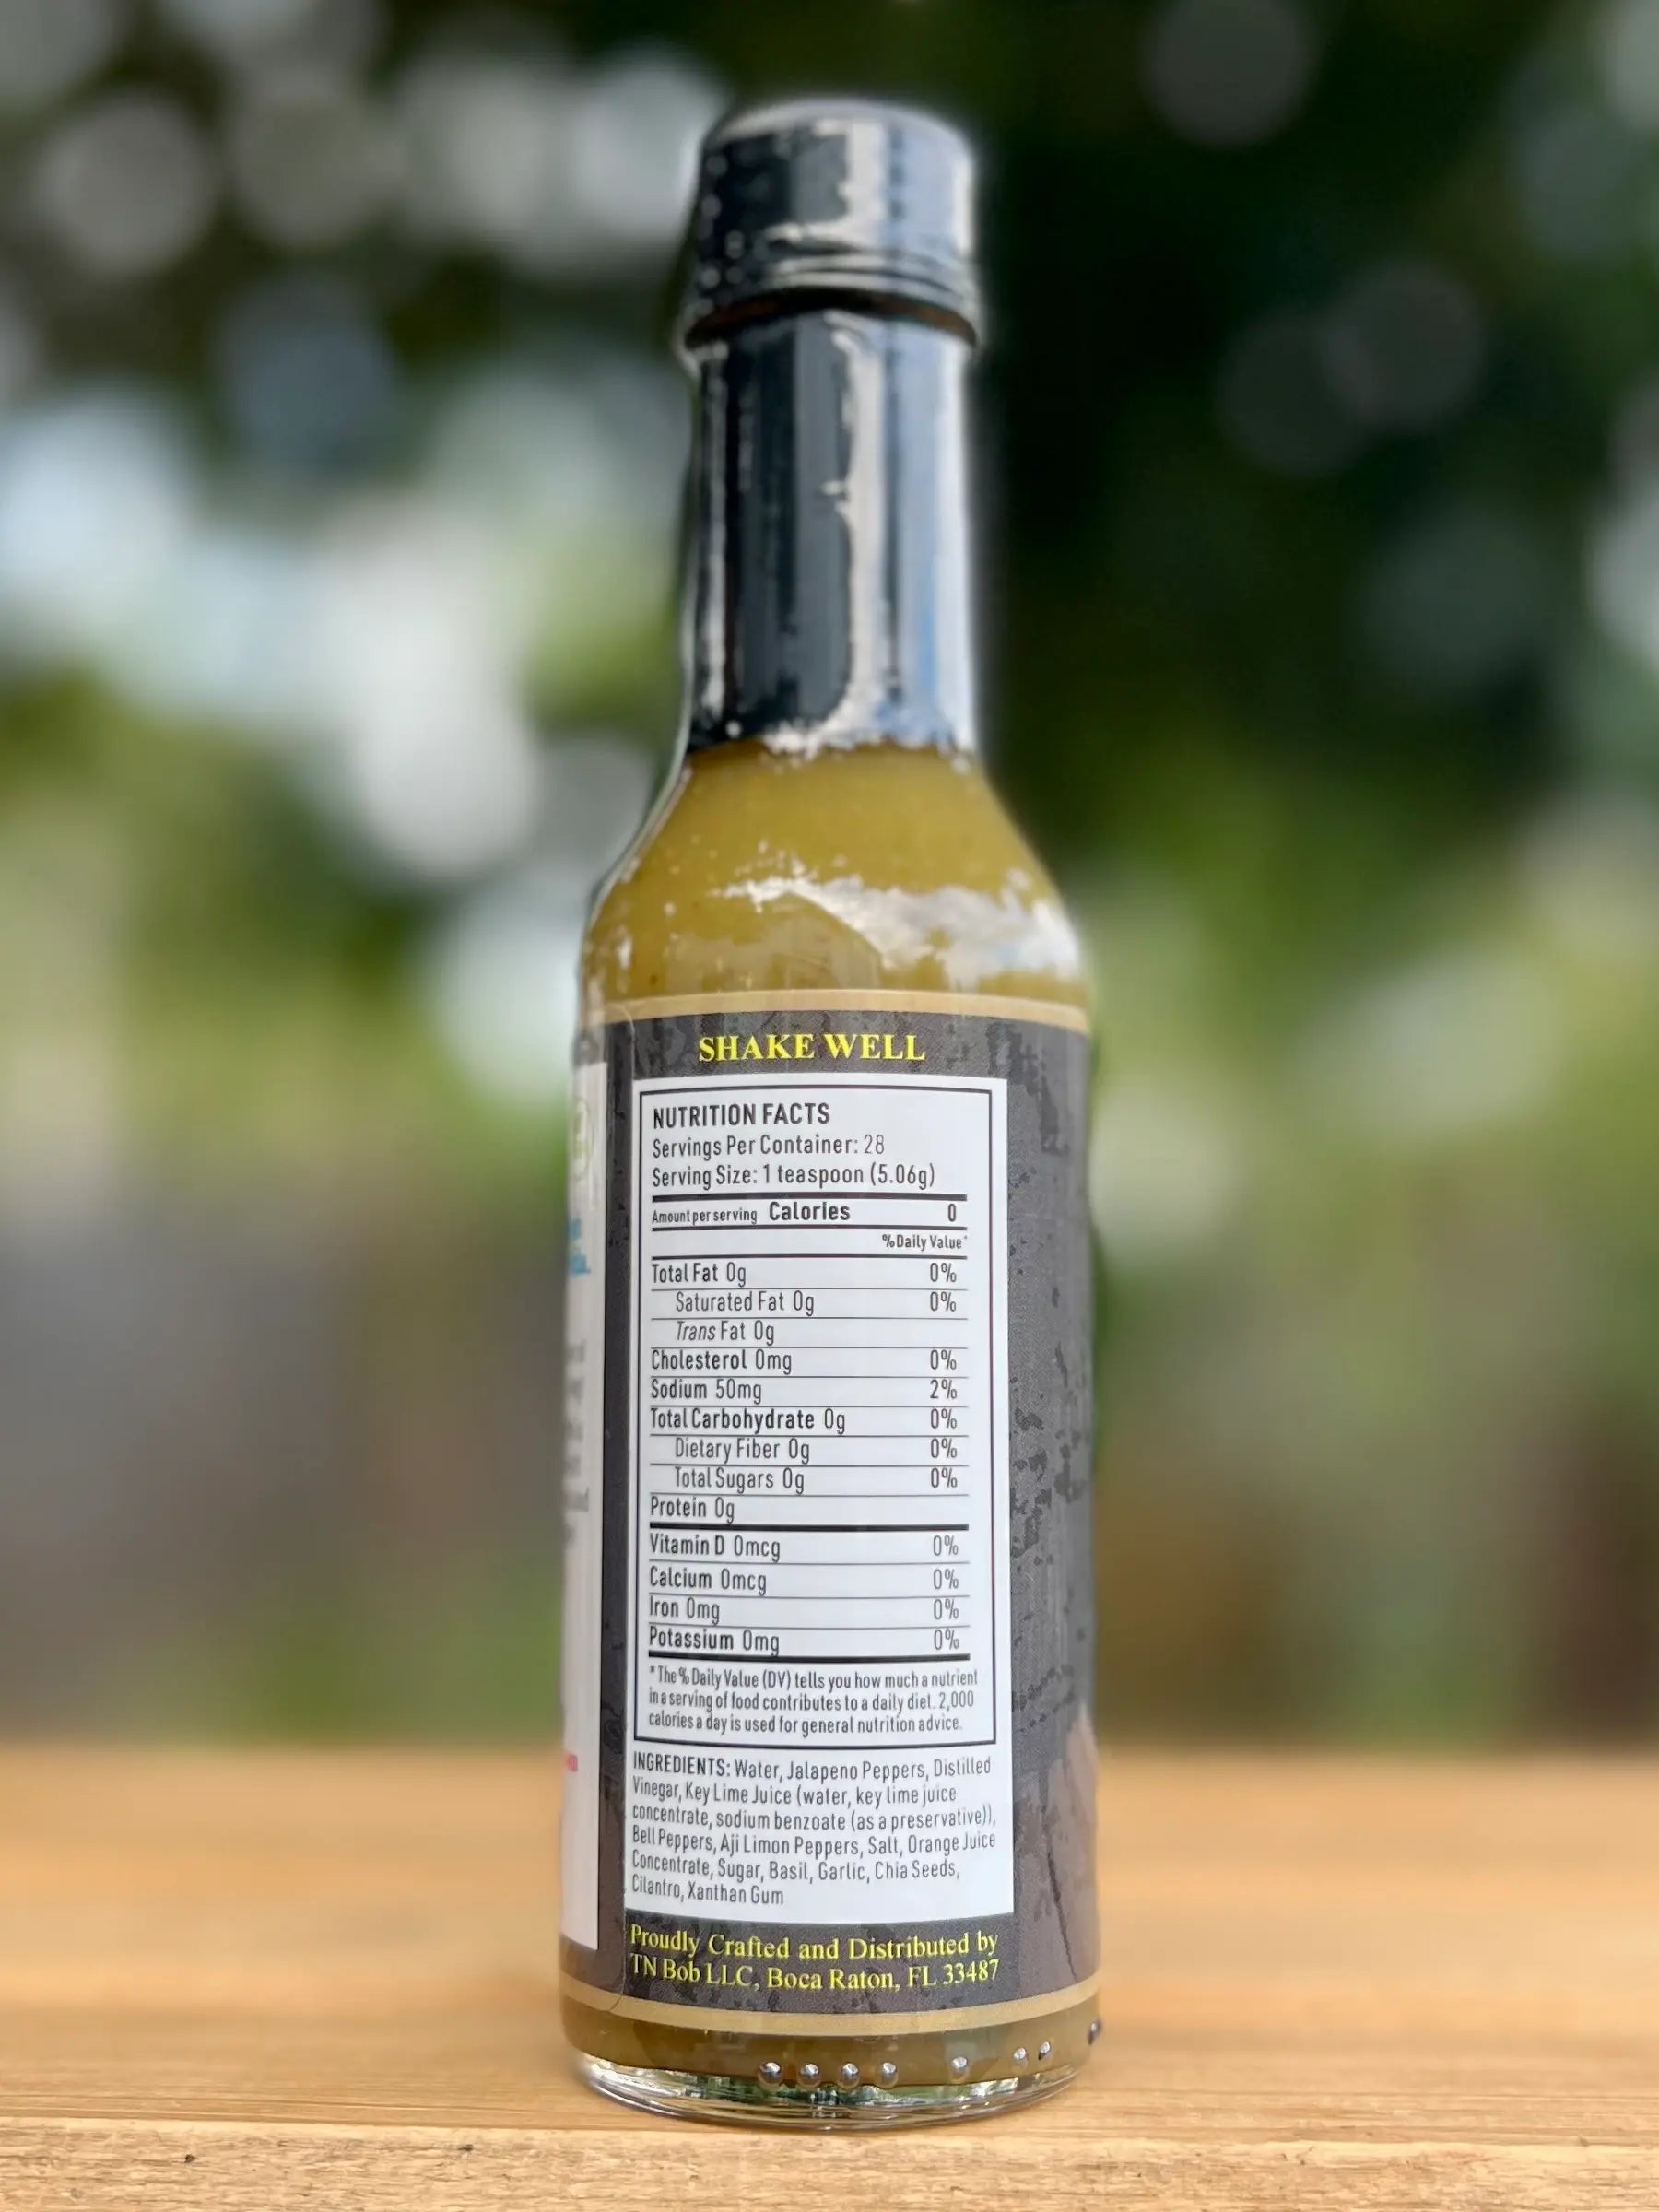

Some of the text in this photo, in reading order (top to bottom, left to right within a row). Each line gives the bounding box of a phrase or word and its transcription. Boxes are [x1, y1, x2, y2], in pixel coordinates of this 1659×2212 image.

[699, 1034, 925, 1062] SHAKE WELL
[653, 1102, 830, 1129] NUTRITION FACTS
[653, 1135, 885, 1161] Servings Per Container: 28
[652, 1163, 935, 1191] Serving Size: 1 teaspoon (5.06g)
[652, 1202, 957, 1226] Amount per serving Calories 0
[652, 1263, 957, 1288] Total Fat 0g 0%
[676, 1291, 957, 1316] Saturated Fat 0g 0%
[677, 1320, 774, 1345] Trans Fat 0g
[652, 1349, 957, 1374] Cholesterol 0mg 0%
[651, 1379, 957, 1404] Sodium 50mg 2%
[651, 1408, 957, 1434] Total Carbohydrate 0g 0%
[675, 1438, 957, 1464] Dietary Fiber 0g 0%
[675, 1467, 957, 1494] Total Sugars 0g 0%
[651, 1496, 735, 1524] Protein 0g
[650, 1535, 959, 1562] Vitamin D 0mcg 0%
[650, 1567, 959, 1595] Calcium 0mcg 0%
[650, 1596, 959, 1625] Iron 0mg 0%
[649, 1626, 959, 1656] Potassium 0mg 0%
[724, 1669, 759, 1688] Value
[762, 1670, 791, 1690] (DV)
[794, 1671, 825, 1688] tells
[829, 1673, 852, 1692] you
[854, 1671, 881, 1688] how
[885, 1670, 918, 1688] much
[922, 1675, 928, 1688] a
[931, 1669, 978, 1688] nutrient
[661, 1692, 666, 1704] a
[668, 1690, 712, 1712] serving
[715, 1691, 728, 1709] of
[731, 1692, 759, 1710] food
[762, 1693, 841, 1711] contributes
[844, 1695, 858, 1711] to
[861, 1698, 868, 1711] a
[872, 1692, 903, 1715] daily
[939, 1690, 974, 1711] 2,000
[649, 1710, 694, 1728] calories
[696, 1716, 702, 1729] a
[706, 1712, 727, 1736] day
[730, 1713, 741, 1732] is
[744, 1714, 776, 1733] used
[779, 1714, 797, 1733] for
[802, 1714, 853, 1738] general
[857, 1715, 915, 1733] nutrition
[634, 1751, 991, 1784] INGREDIENTS: Water, Jalapeno Peppers, Distilled
[633, 1776, 956, 1809] Vinegar, Key Lime Juice (water, key lime juice
[633, 1804, 712, 1830] concentrate,
[716, 1809, 770, 1829] sodium
[774, 1811, 846, 1830] benzoate
[851, 1809, 875, 1832] (as
[878, 1815, 887, 1830] a
[633, 1825, 995, 1860] Bell Peppers, Aji Limon Peppers, Salt, Orange Juice
[632, 1850, 960, 1883] Concentrate, Sugar, Basil, Garlic, Chia Seeds,
[632, 1875, 783, 1904] Cilantro, Xanthan Gum
[629, 1924, 998, 1959] Proudly Crafted and Distributed by
[630, 1954, 1000, 1992] TN Bob LLC, Boca Raton, FL 33487
